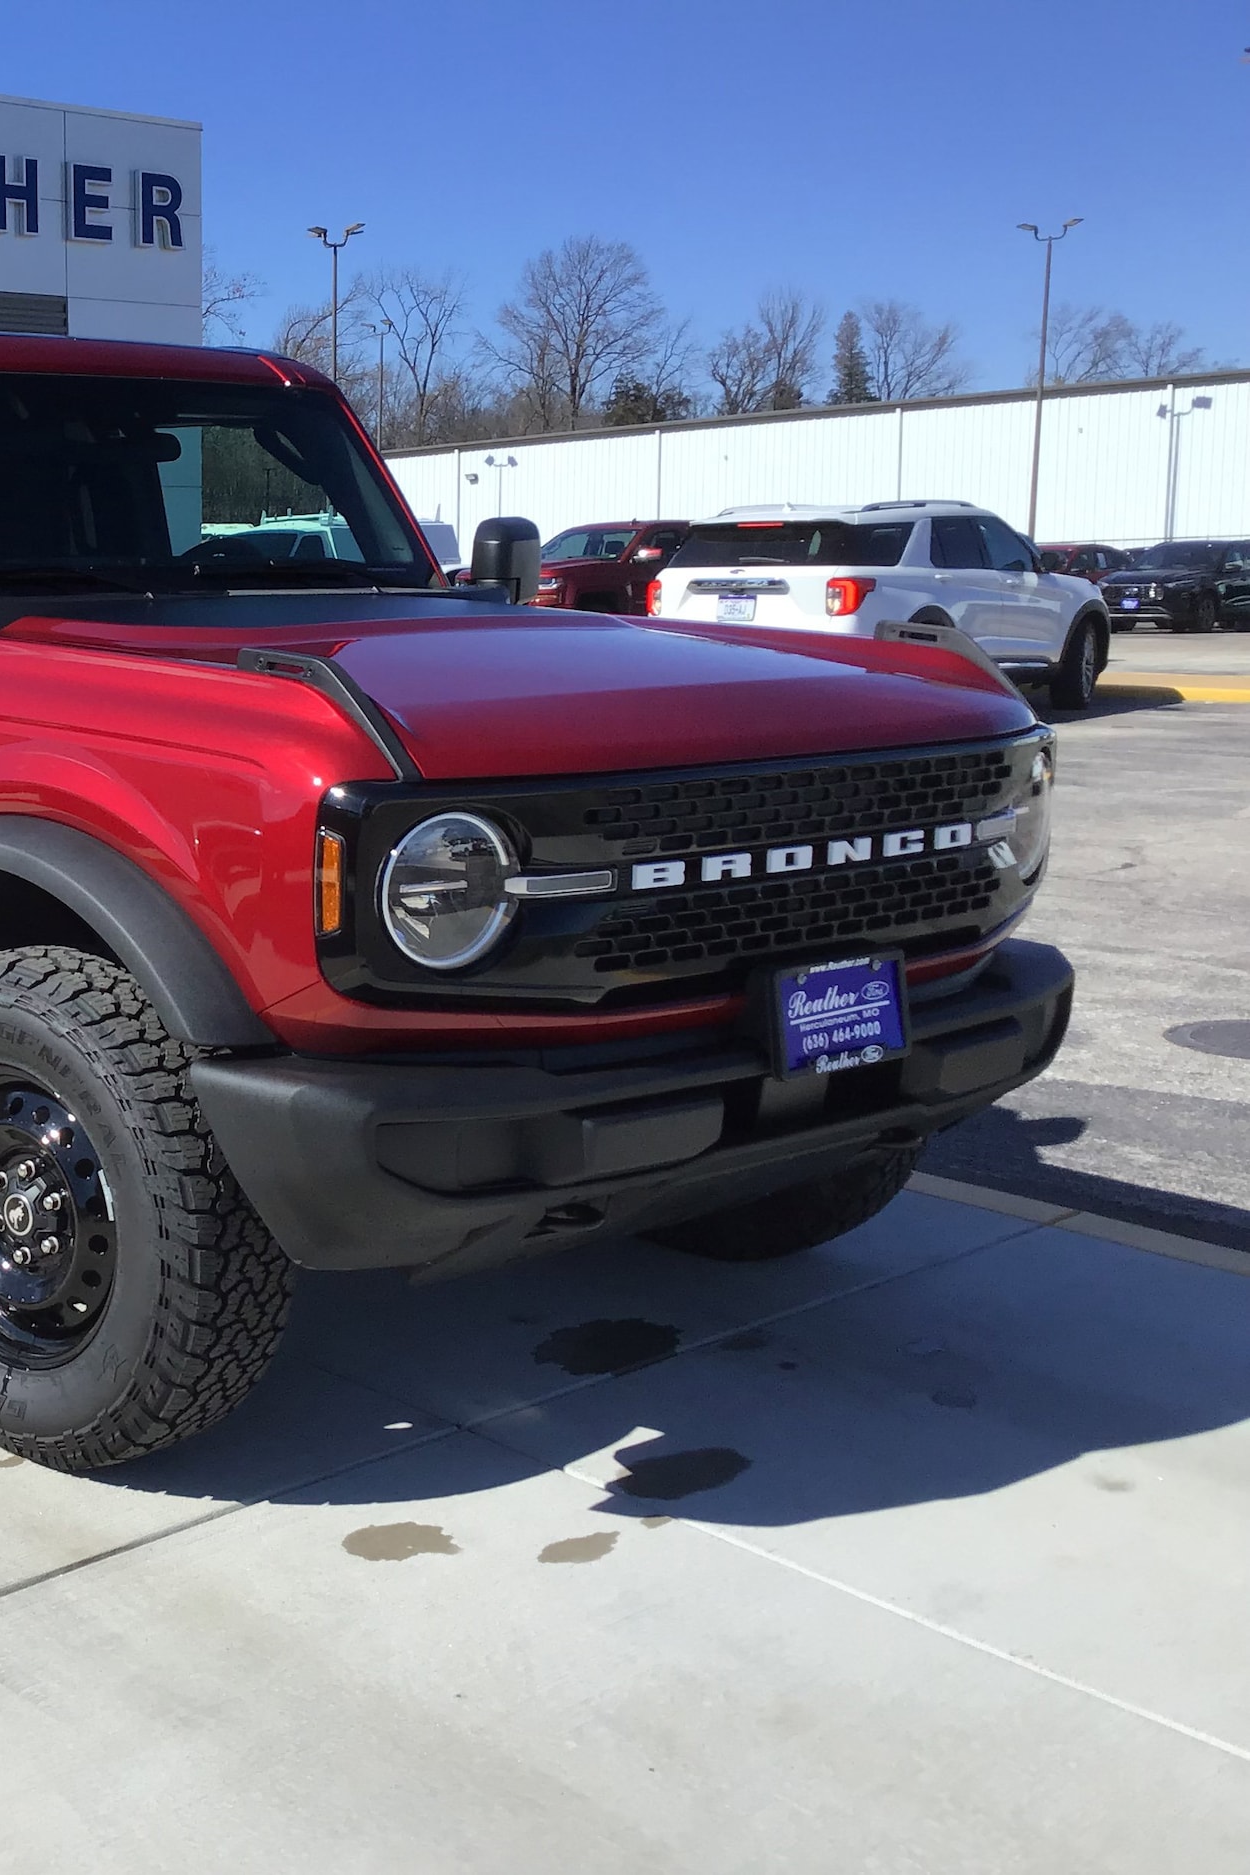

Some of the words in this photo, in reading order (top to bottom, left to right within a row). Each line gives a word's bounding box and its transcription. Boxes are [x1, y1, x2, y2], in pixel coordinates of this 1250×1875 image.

[632, 823, 972, 890] BRONCO
[788, 985, 859, 1019] Reuther
[862, 1008, 880, 1019] MO
[802, 1032, 829, 1054] (636)
[831, 1021, 881, 1043] 464-9000
[816, 1051, 861, 1074] Reuther
